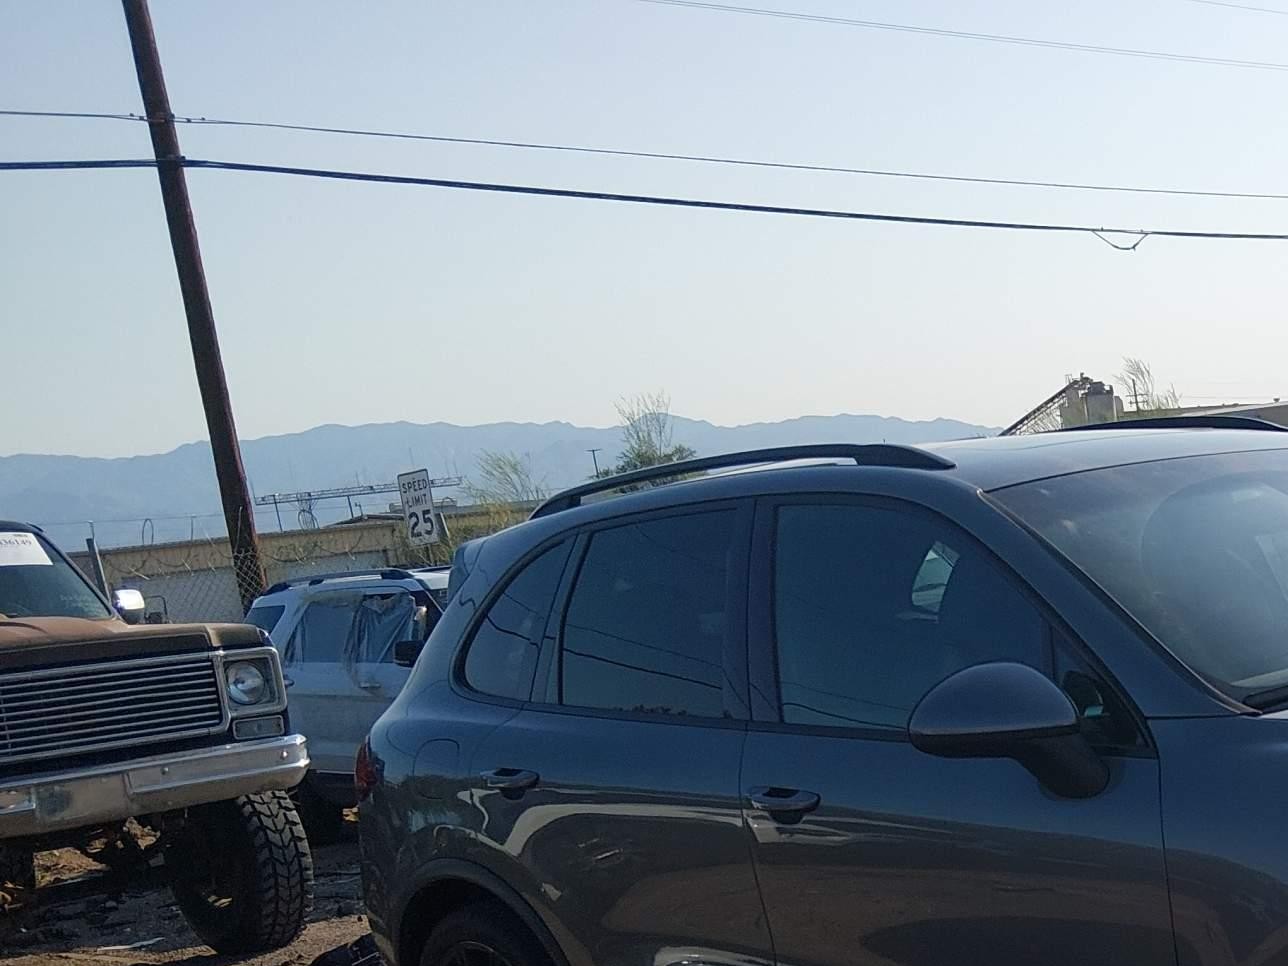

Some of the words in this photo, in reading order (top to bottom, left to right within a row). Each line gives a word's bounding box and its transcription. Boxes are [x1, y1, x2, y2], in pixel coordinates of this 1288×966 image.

[402, 479, 427, 493] SPEED
[407, 494, 427, 507] LIMIT
[408, 509, 434, 538] 25
